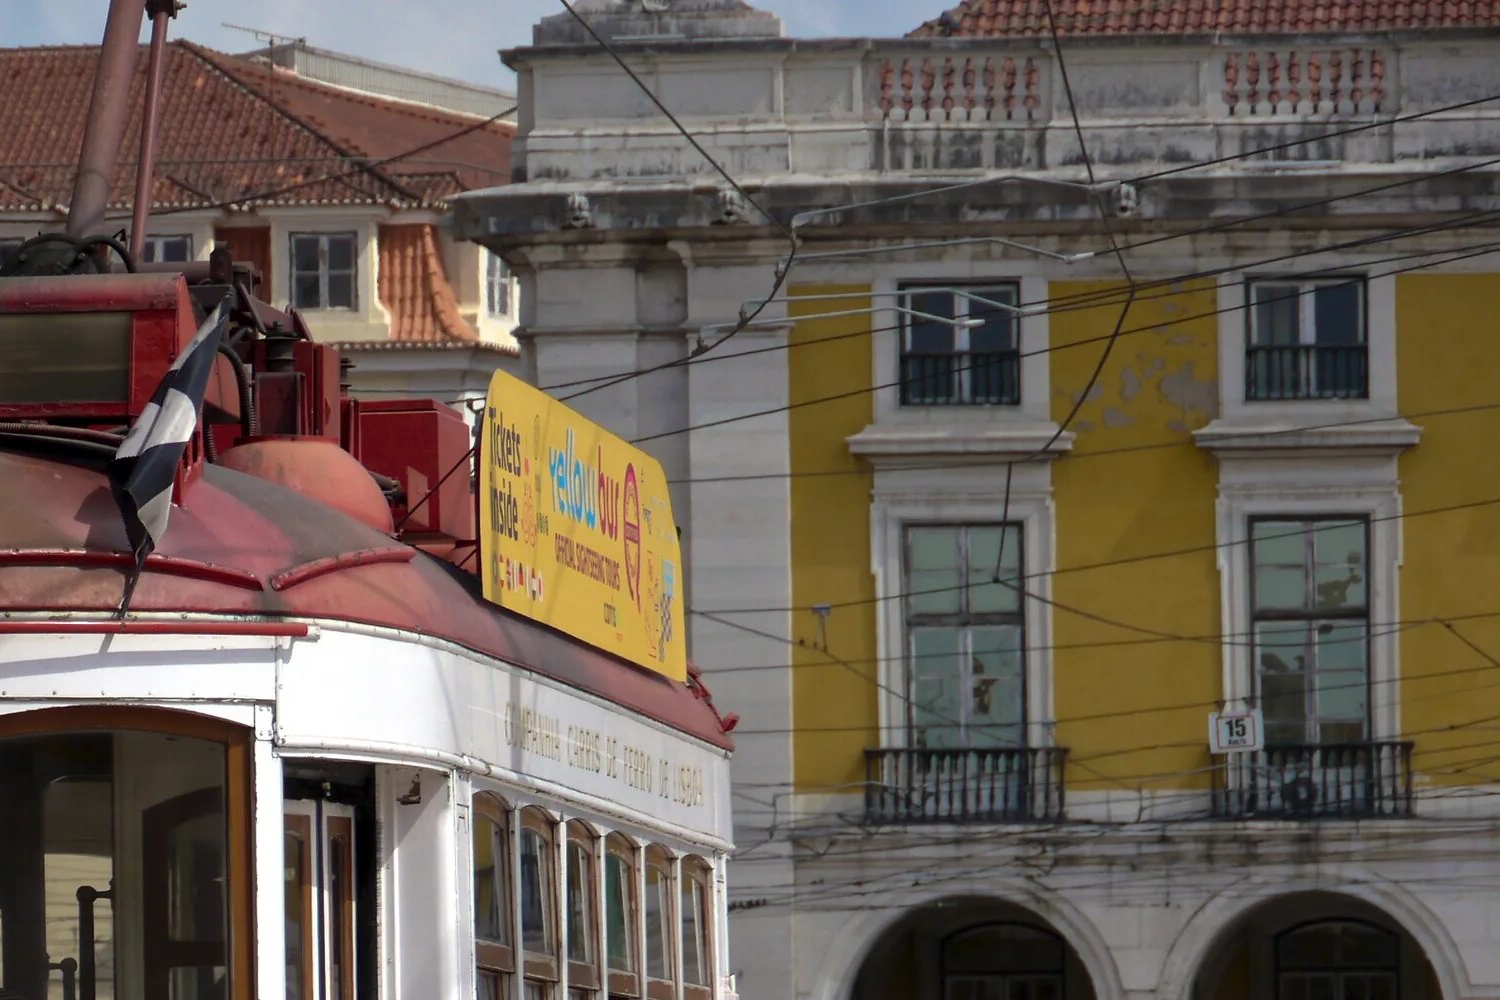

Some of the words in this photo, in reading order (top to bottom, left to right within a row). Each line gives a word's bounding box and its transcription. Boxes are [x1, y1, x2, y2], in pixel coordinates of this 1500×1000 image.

[489, 406, 521, 477] Tickets
[490, 472, 519, 541] inside
[549, 427, 597, 529] yellow
[597, 445, 619, 542] bus
[555, 533, 576, 569] OFFICIAL
[576, 542, 605, 584] SIGHTSEEING
[604, 556, 620, 591] TOURS
[1225, 719, 1246, 737] 15
[567, 724, 601, 774] CARRIS
[606, 735, 617, 779] DE
[660, 758, 669, 799] DE
[673, 762, 704, 807] LISBOA
